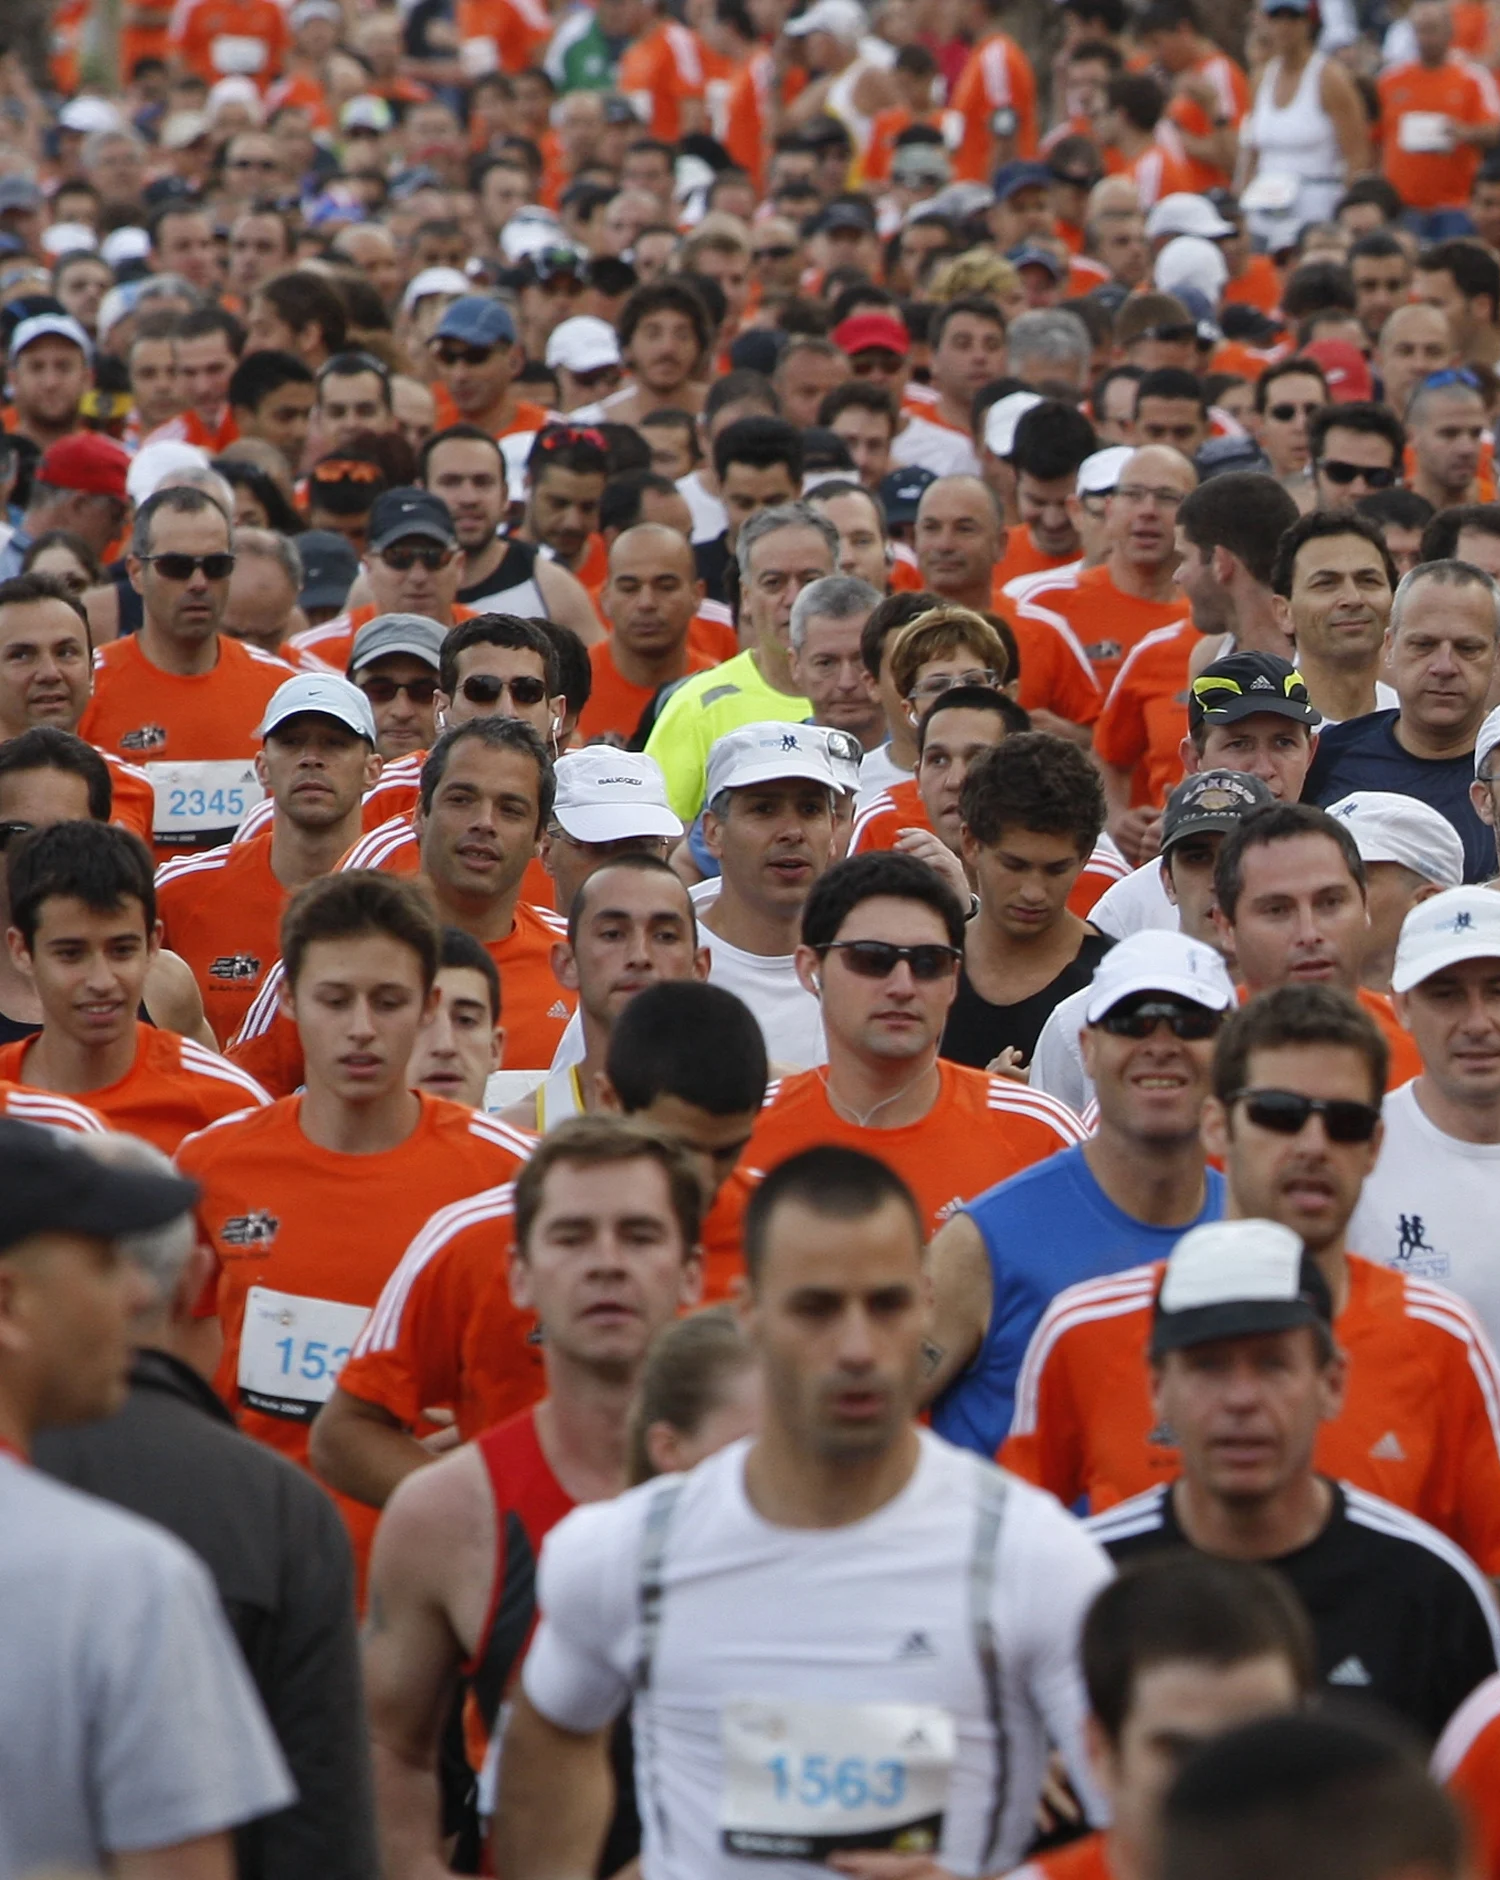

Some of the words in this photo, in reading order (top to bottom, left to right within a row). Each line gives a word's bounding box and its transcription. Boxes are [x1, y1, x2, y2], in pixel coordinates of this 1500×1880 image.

[169, 789, 244, 816] 2345
[1181, 777, 1256, 805] LAKERS
[767, 1754, 907, 1810] 1563
